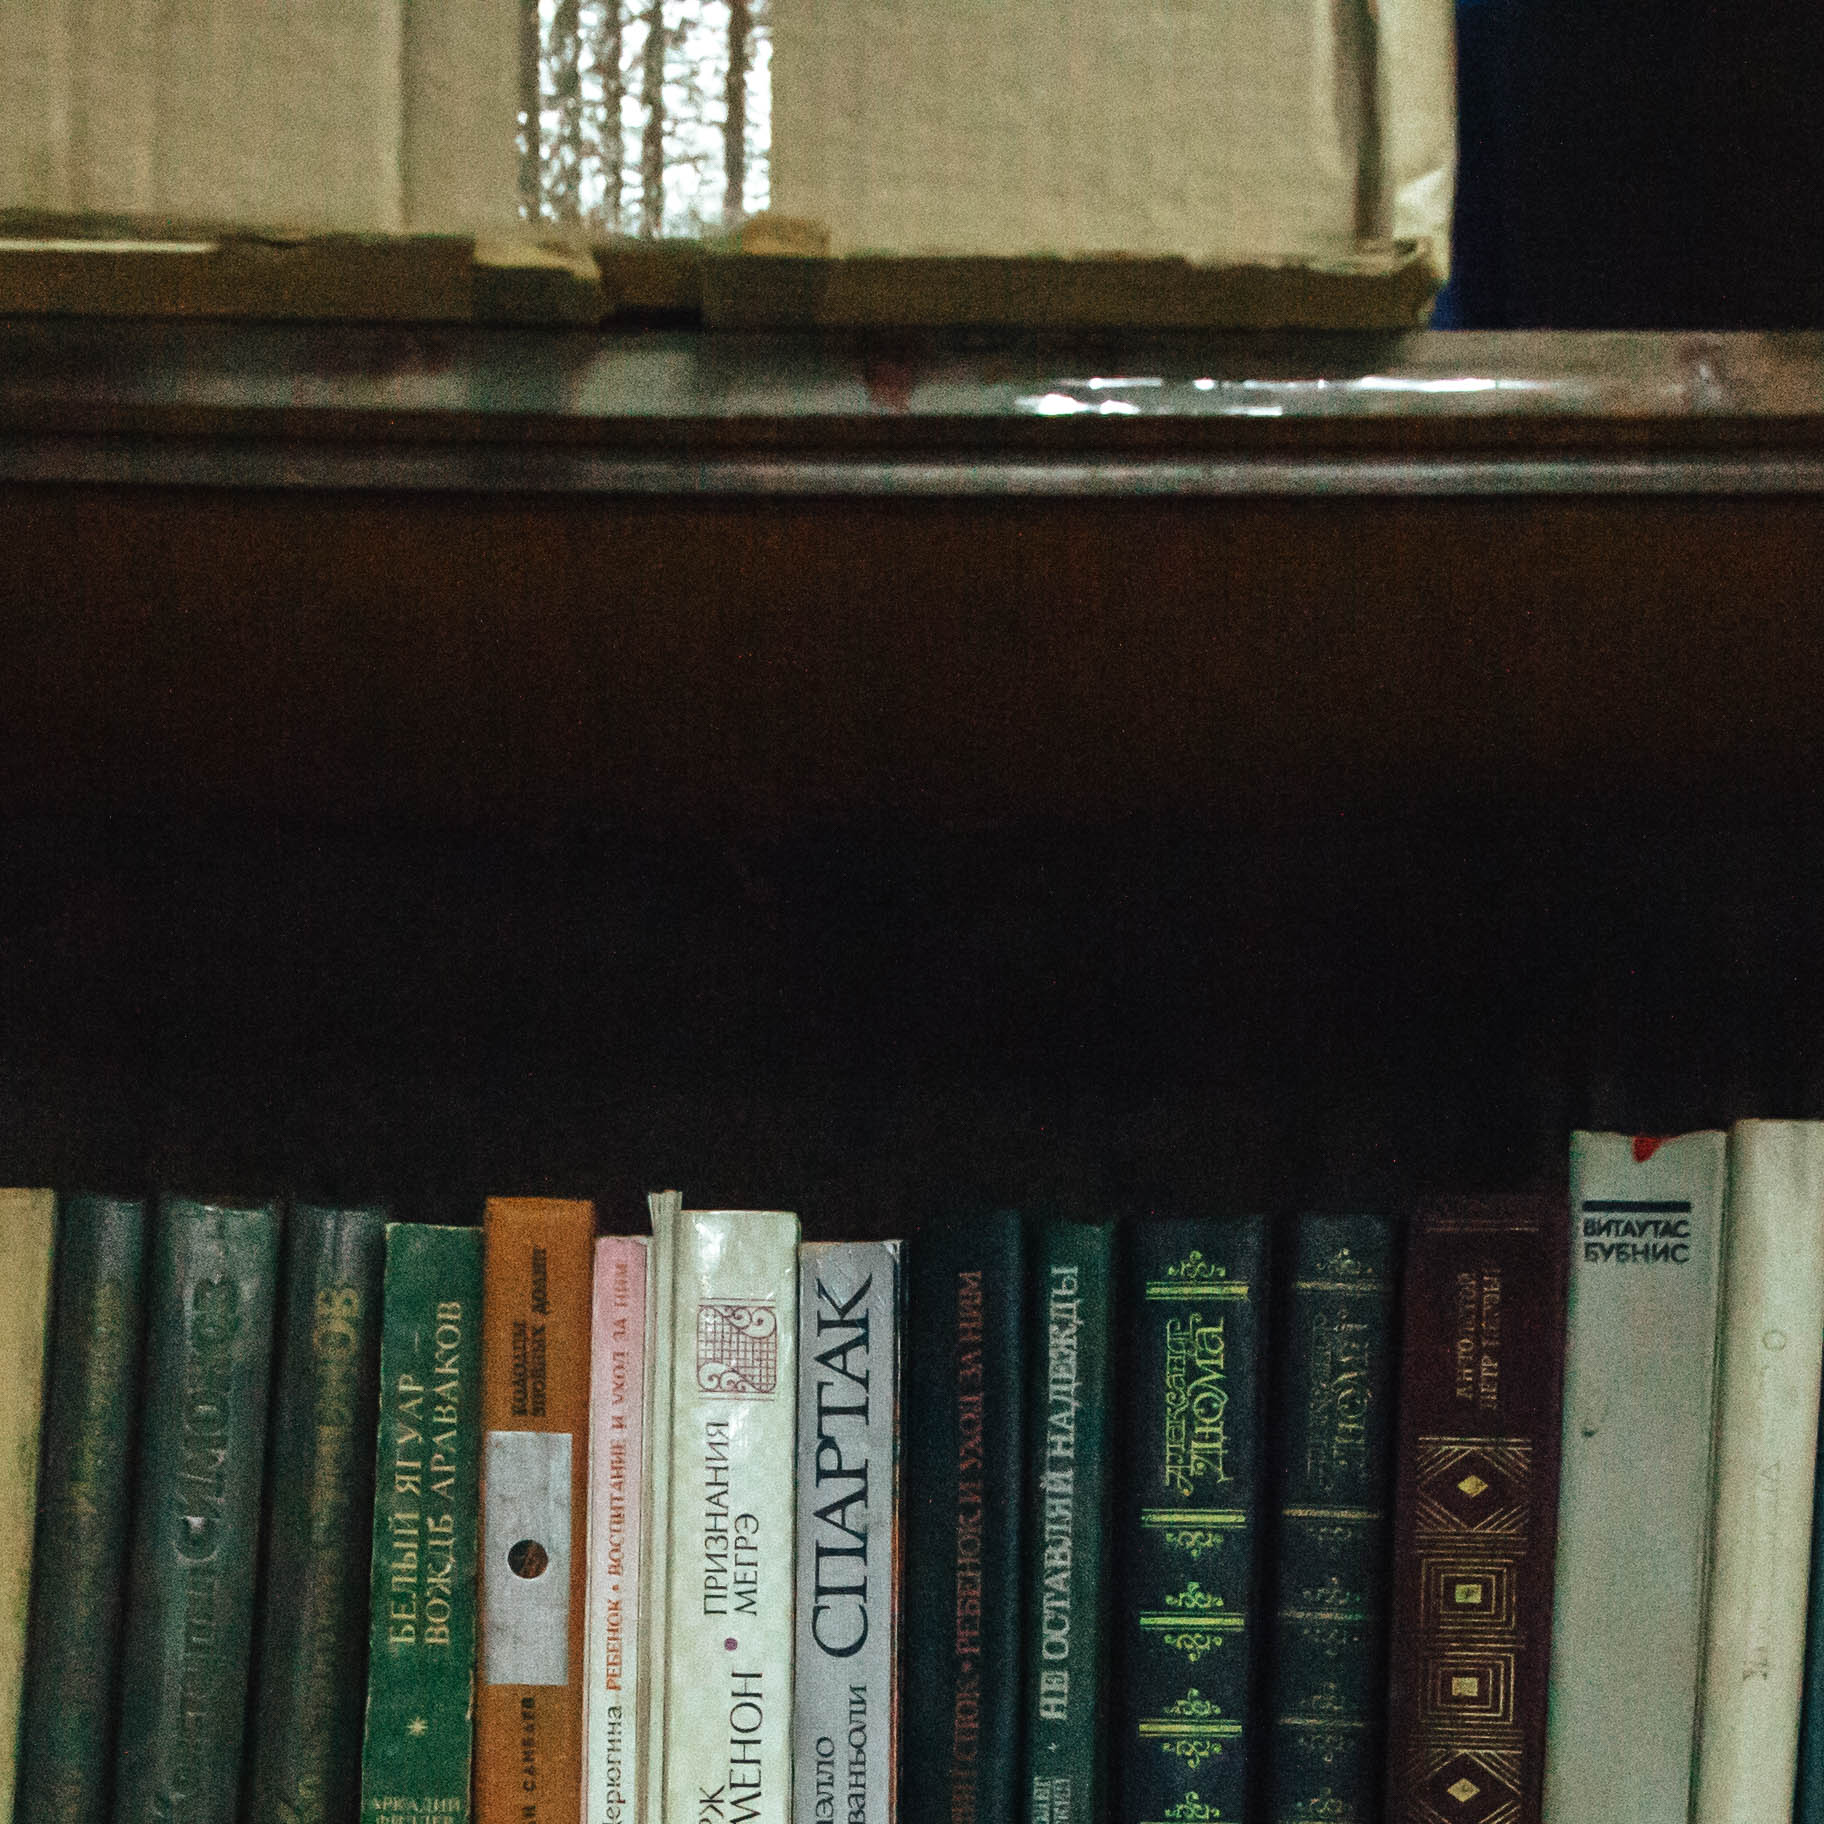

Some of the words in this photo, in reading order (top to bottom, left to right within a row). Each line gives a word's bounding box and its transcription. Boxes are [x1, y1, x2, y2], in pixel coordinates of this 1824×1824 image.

[1582, 1218, 1691, 1239] ВИТАУТАС
[1584, 1243, 1690, 1264] БУБНИС
[530, 1246, 551, 1314] ДОЛИН
[612, 1314, 630, 1342] ЗА
[613, 1260, 632, 1306] НИМ
[956, 1269, 983, 1342] НИМ
[430, 1298, 465, 1500] АРАВАКОВ
[611, 1348, 631, 1406] УХОД
[1048, 1264, 1083, 1457] НАДЕЖДЫ
[393, 1371, 425, 1494] ЯГУАР
[610, 1413, 628, 1429] И
[811, 1271, 874, 1657] СПАРТАК
[607, 1438, 628, 1576] ВОСПИТАНИЕ
[702, 1420, 730, 1616] ПРИЗНАНИЯ
[957, 1477, 982, 1502] И
[385, 1510, 421, 1644] БЕЛЫЙ
[426, 1513, 456, 1646] ВОЖДЬ
[733, 1511, 760, 1616] МЕГРЭ
[954, 1509, 983, 1655] РЕБЕНОК
[1038, 1465, 1075, 1660] ОСТАВЛЯЙ
[605, 1598, 625, 1691] РЕБЕНОК
[1038, 1669, 1070, 1720] НЕ
